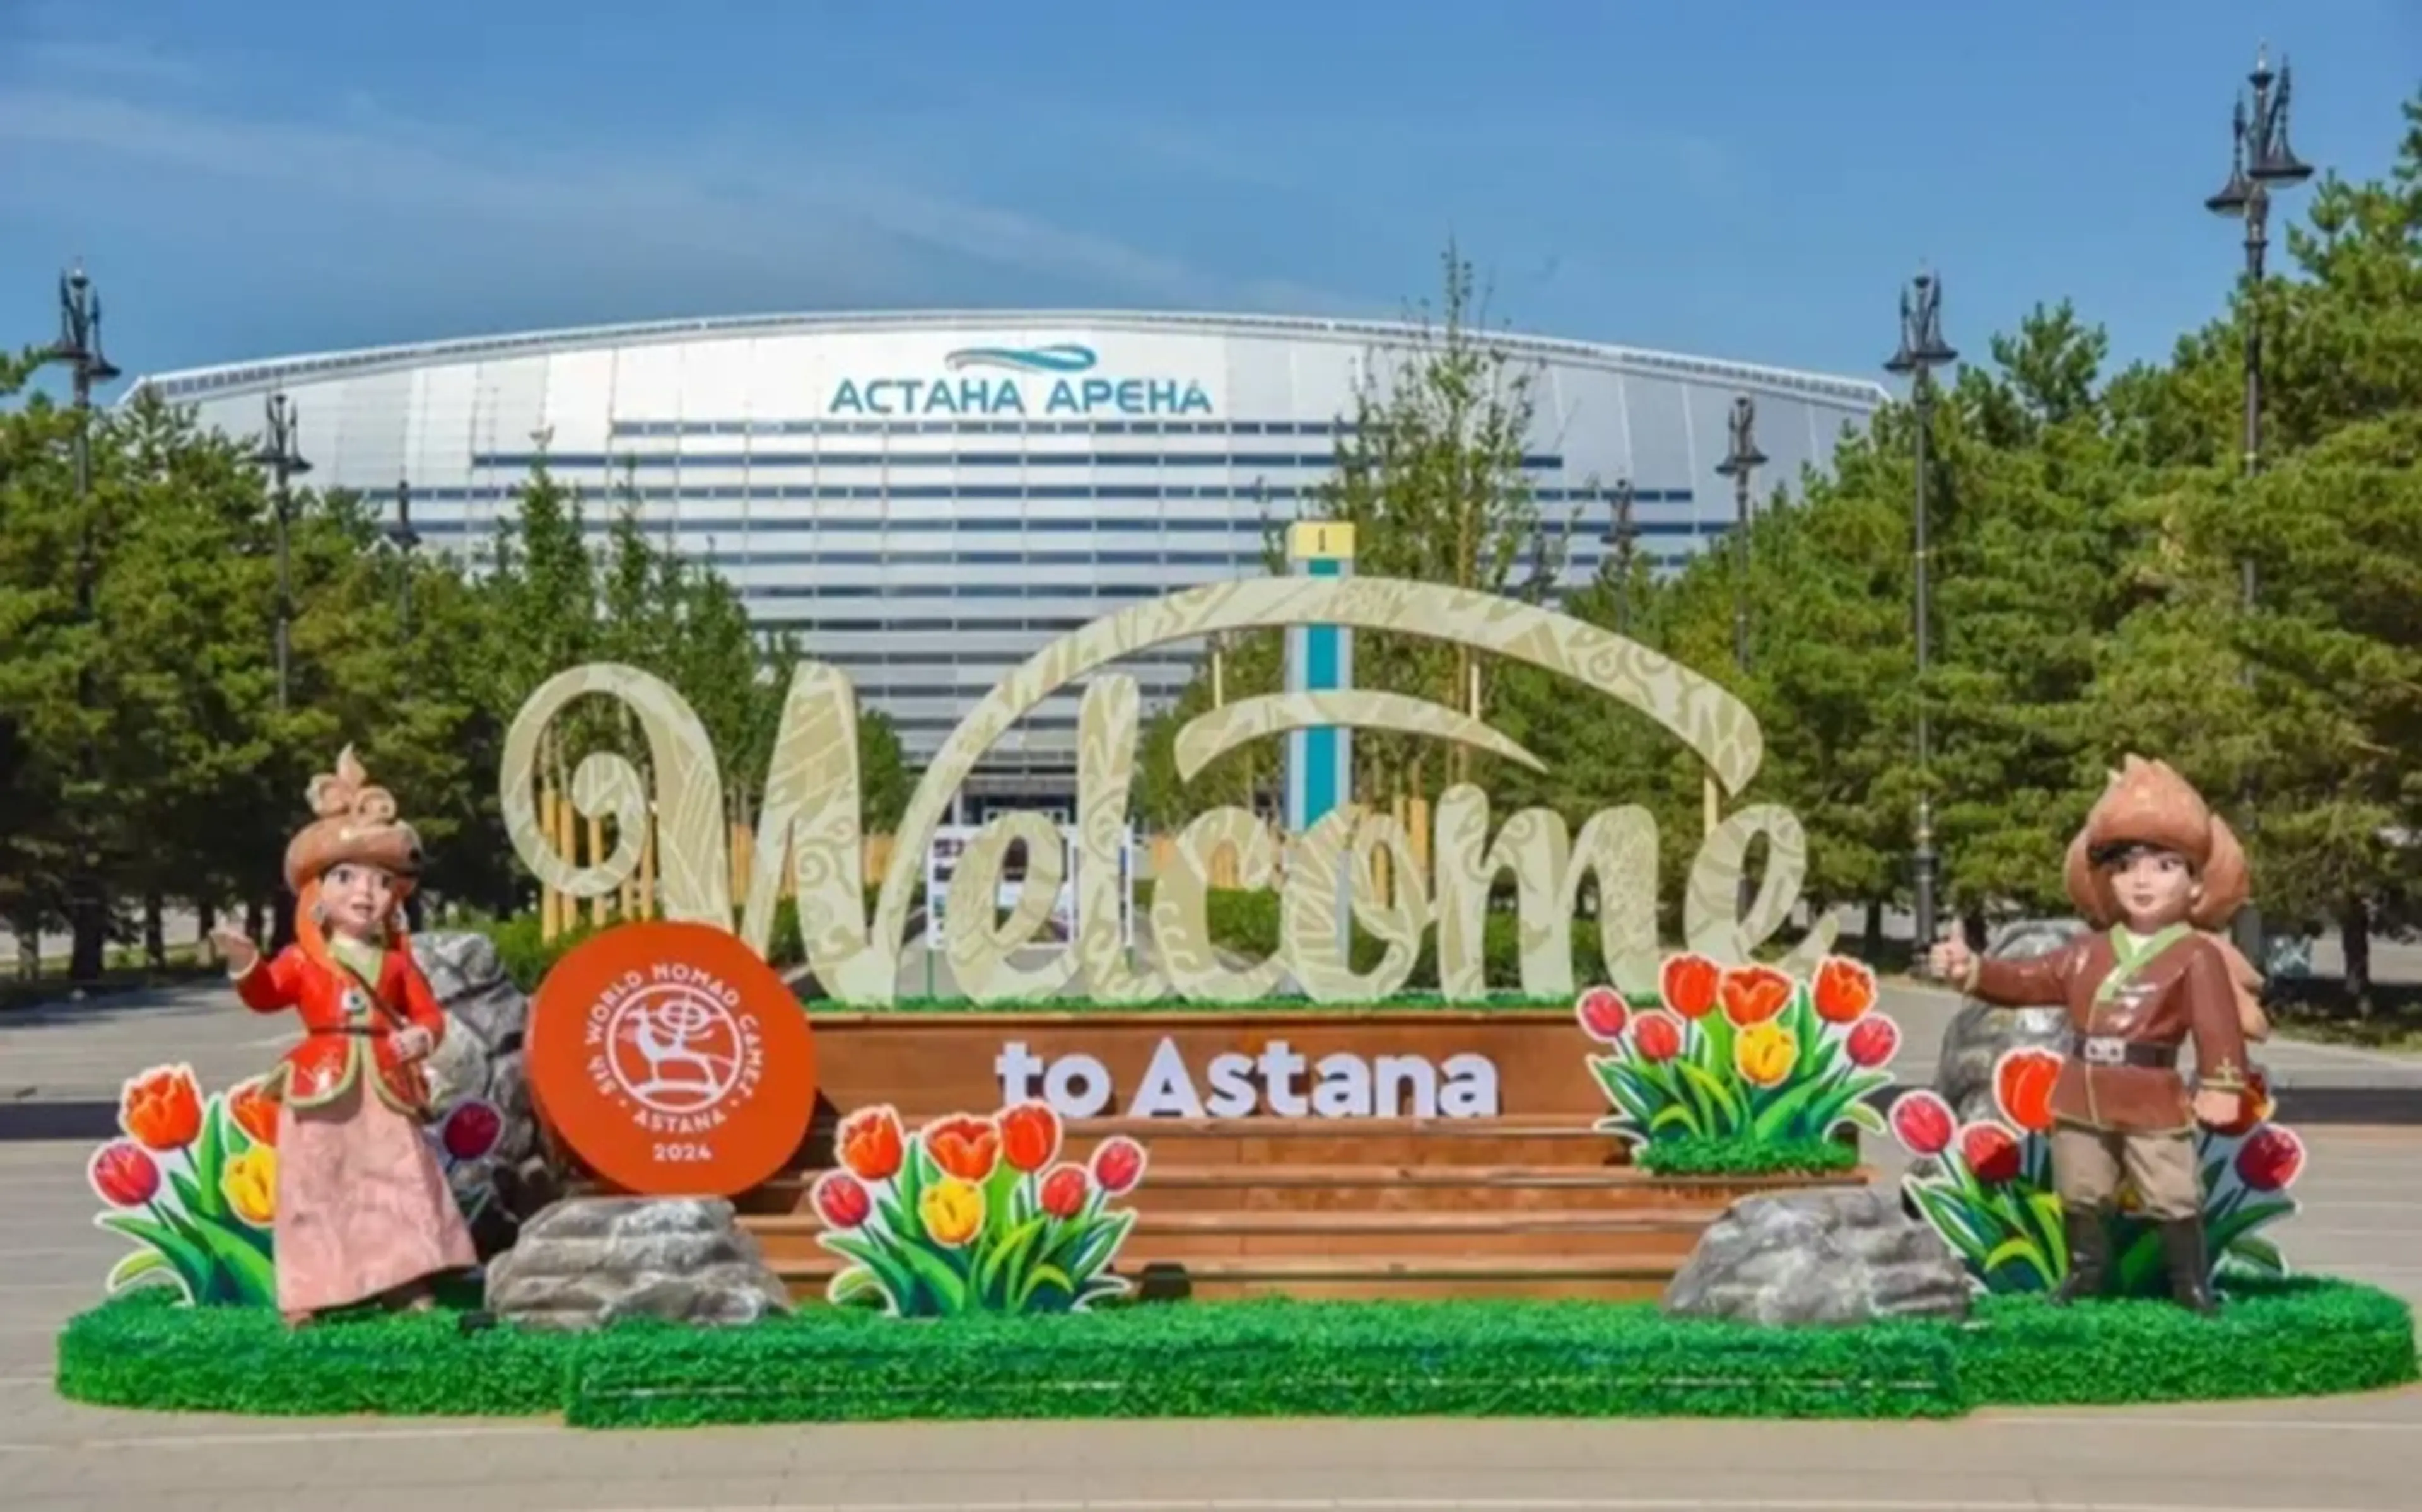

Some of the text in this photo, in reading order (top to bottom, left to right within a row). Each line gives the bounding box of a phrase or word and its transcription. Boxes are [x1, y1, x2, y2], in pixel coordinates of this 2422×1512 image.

[828, 378, 1214, 414] АСТАНА АРЕНА
[500, 577, 1839, 1006] Welcome
[585, 969, 643, 1045] WORLD
[650, 962, 740, 1008] NOMAD
[995, 1035, 1502, 1117] to Astana
[633, 1108, 727, 1134] ASTANA
[653, 1143, 713, 1162] 2024
